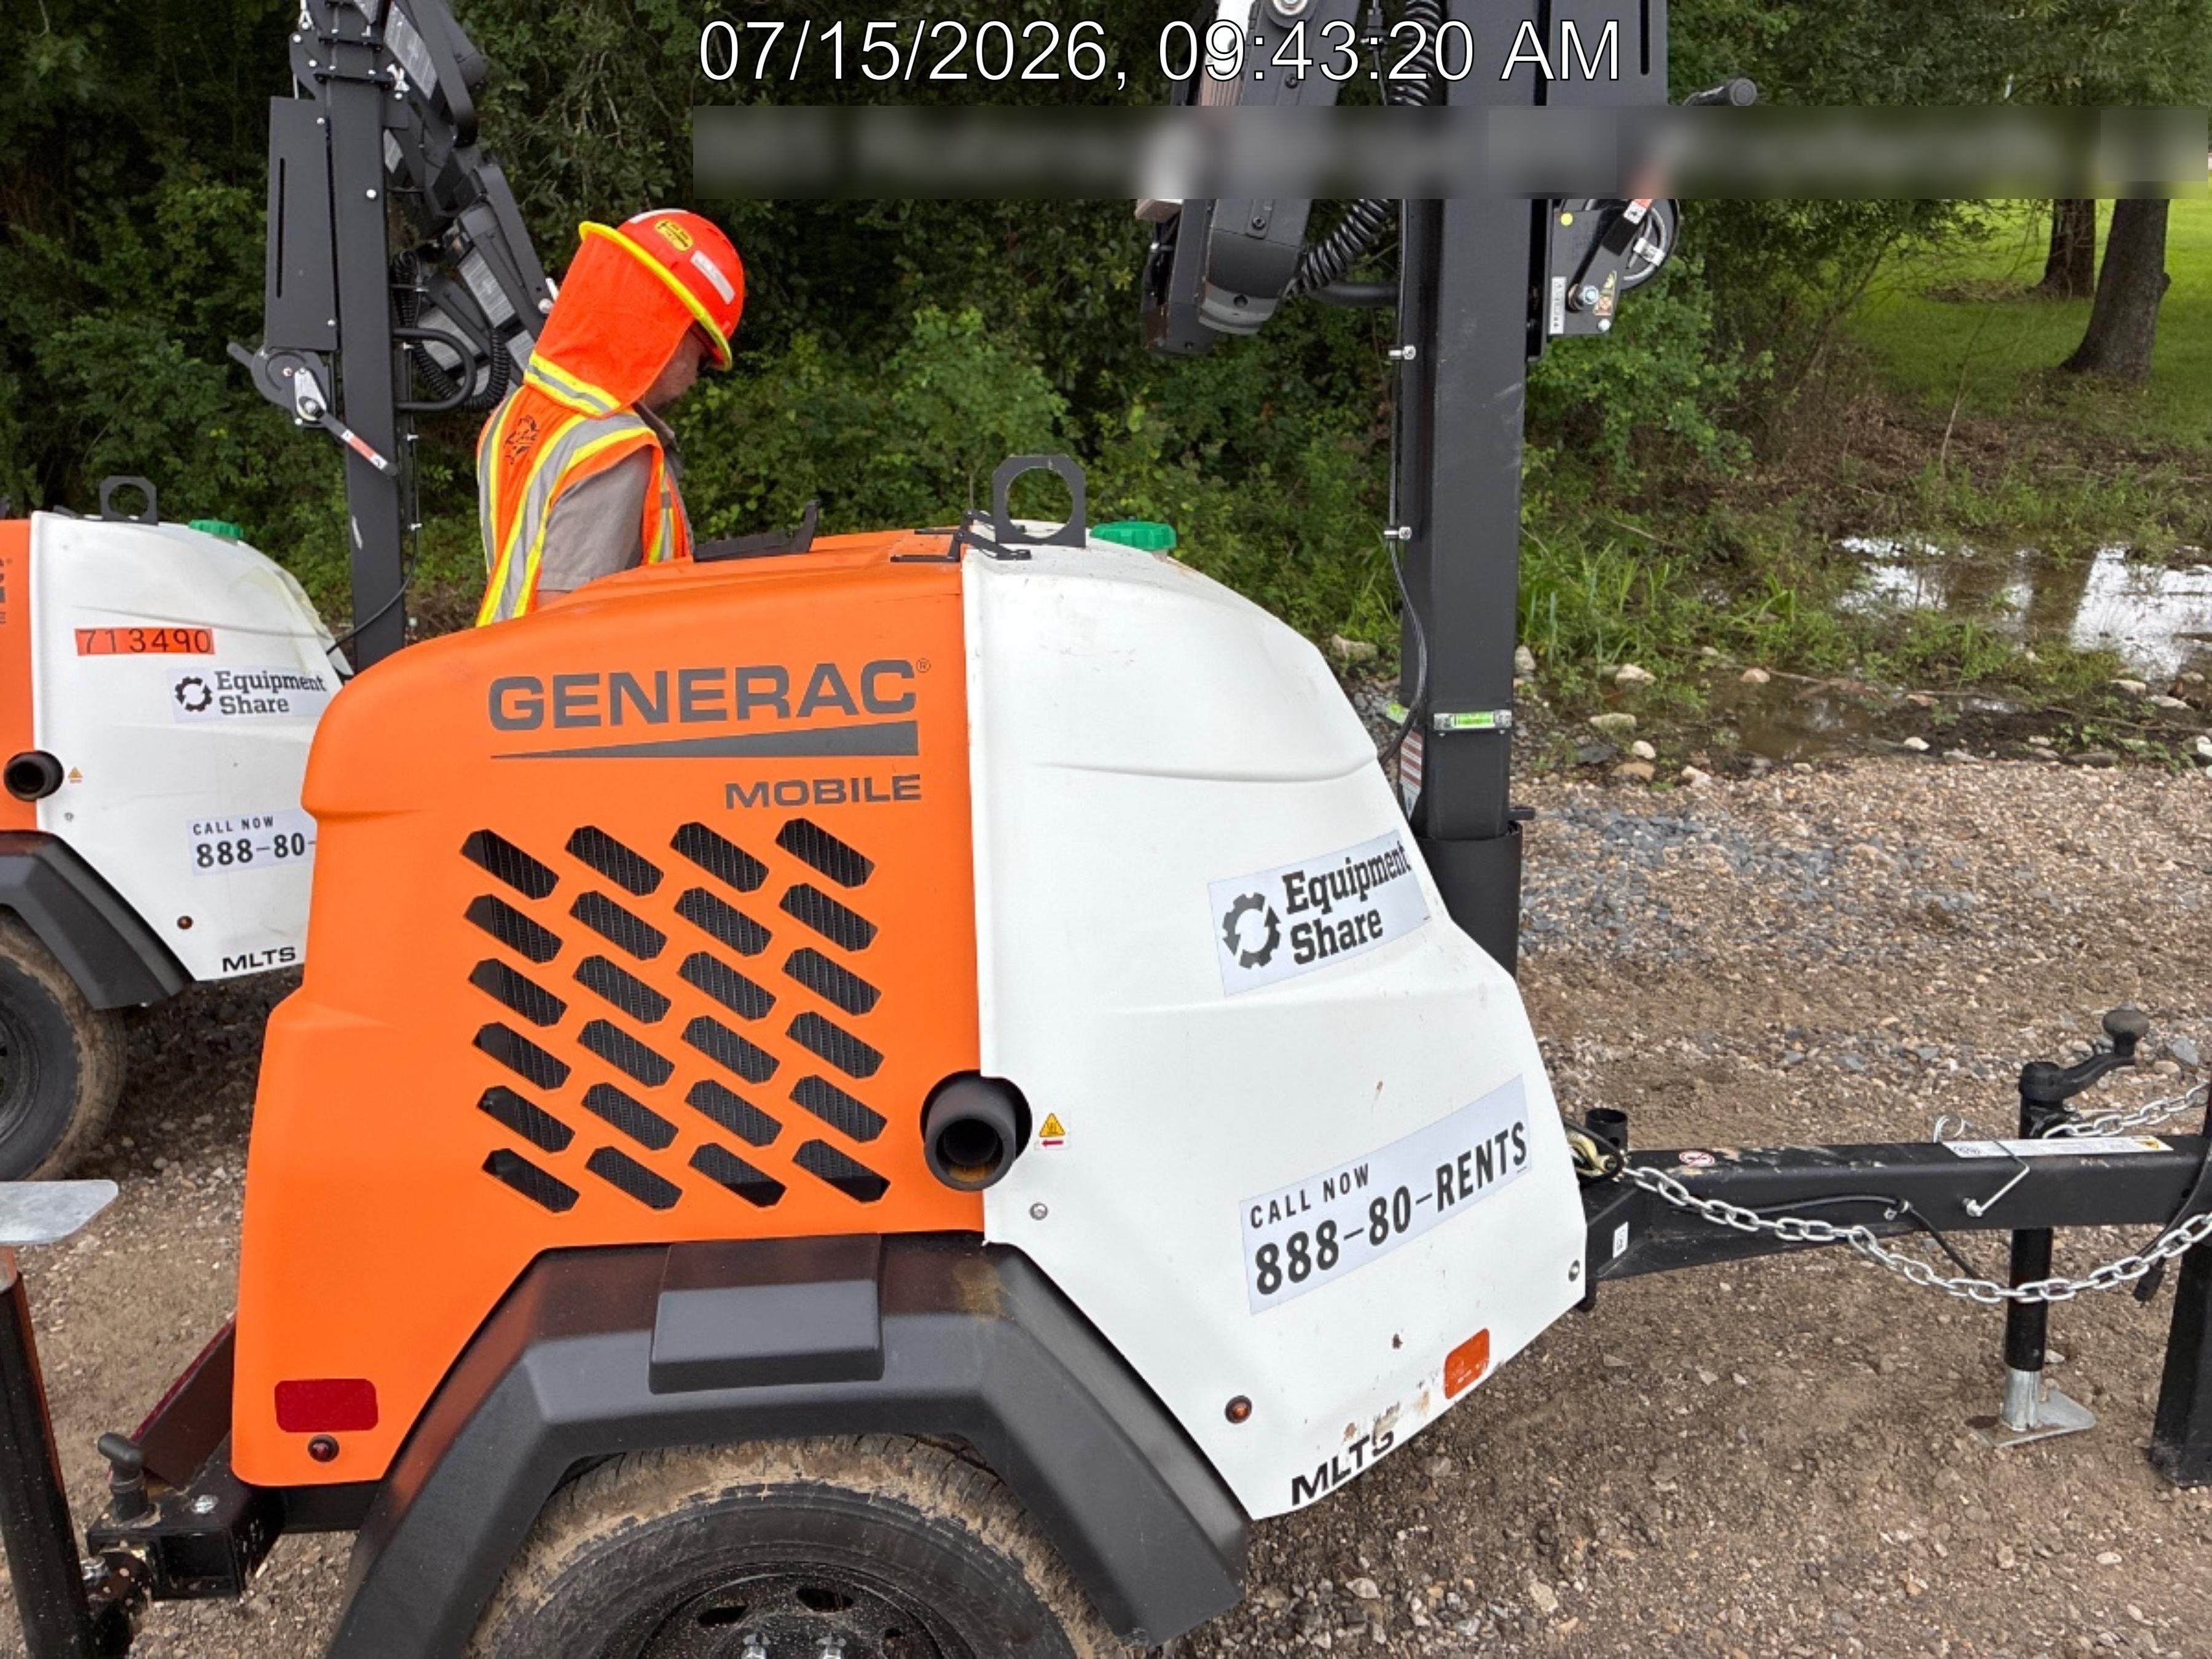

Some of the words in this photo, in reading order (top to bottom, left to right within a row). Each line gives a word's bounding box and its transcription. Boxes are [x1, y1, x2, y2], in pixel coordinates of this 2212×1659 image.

[79, 628, 211, 653] 713490
[214, 670, 326, 694] Equipment
[219, 696, 289, 715] Share
[726, 774, 920, 809] MOBILE
[193, 820, 233, 835] CALL
[241, 816, 273, 830] NOW
[1282, 840, 1412, 914] Equipment
[1290, 909, 1383, 965] Share
[222, 947, 296, 971] MLTS
[1250, 1189, 1311, 1228] CALL
[1322, 1163, 1369, 1202] NOW
[1255, 1121, 1528, 1295] 888-80-RENTS
